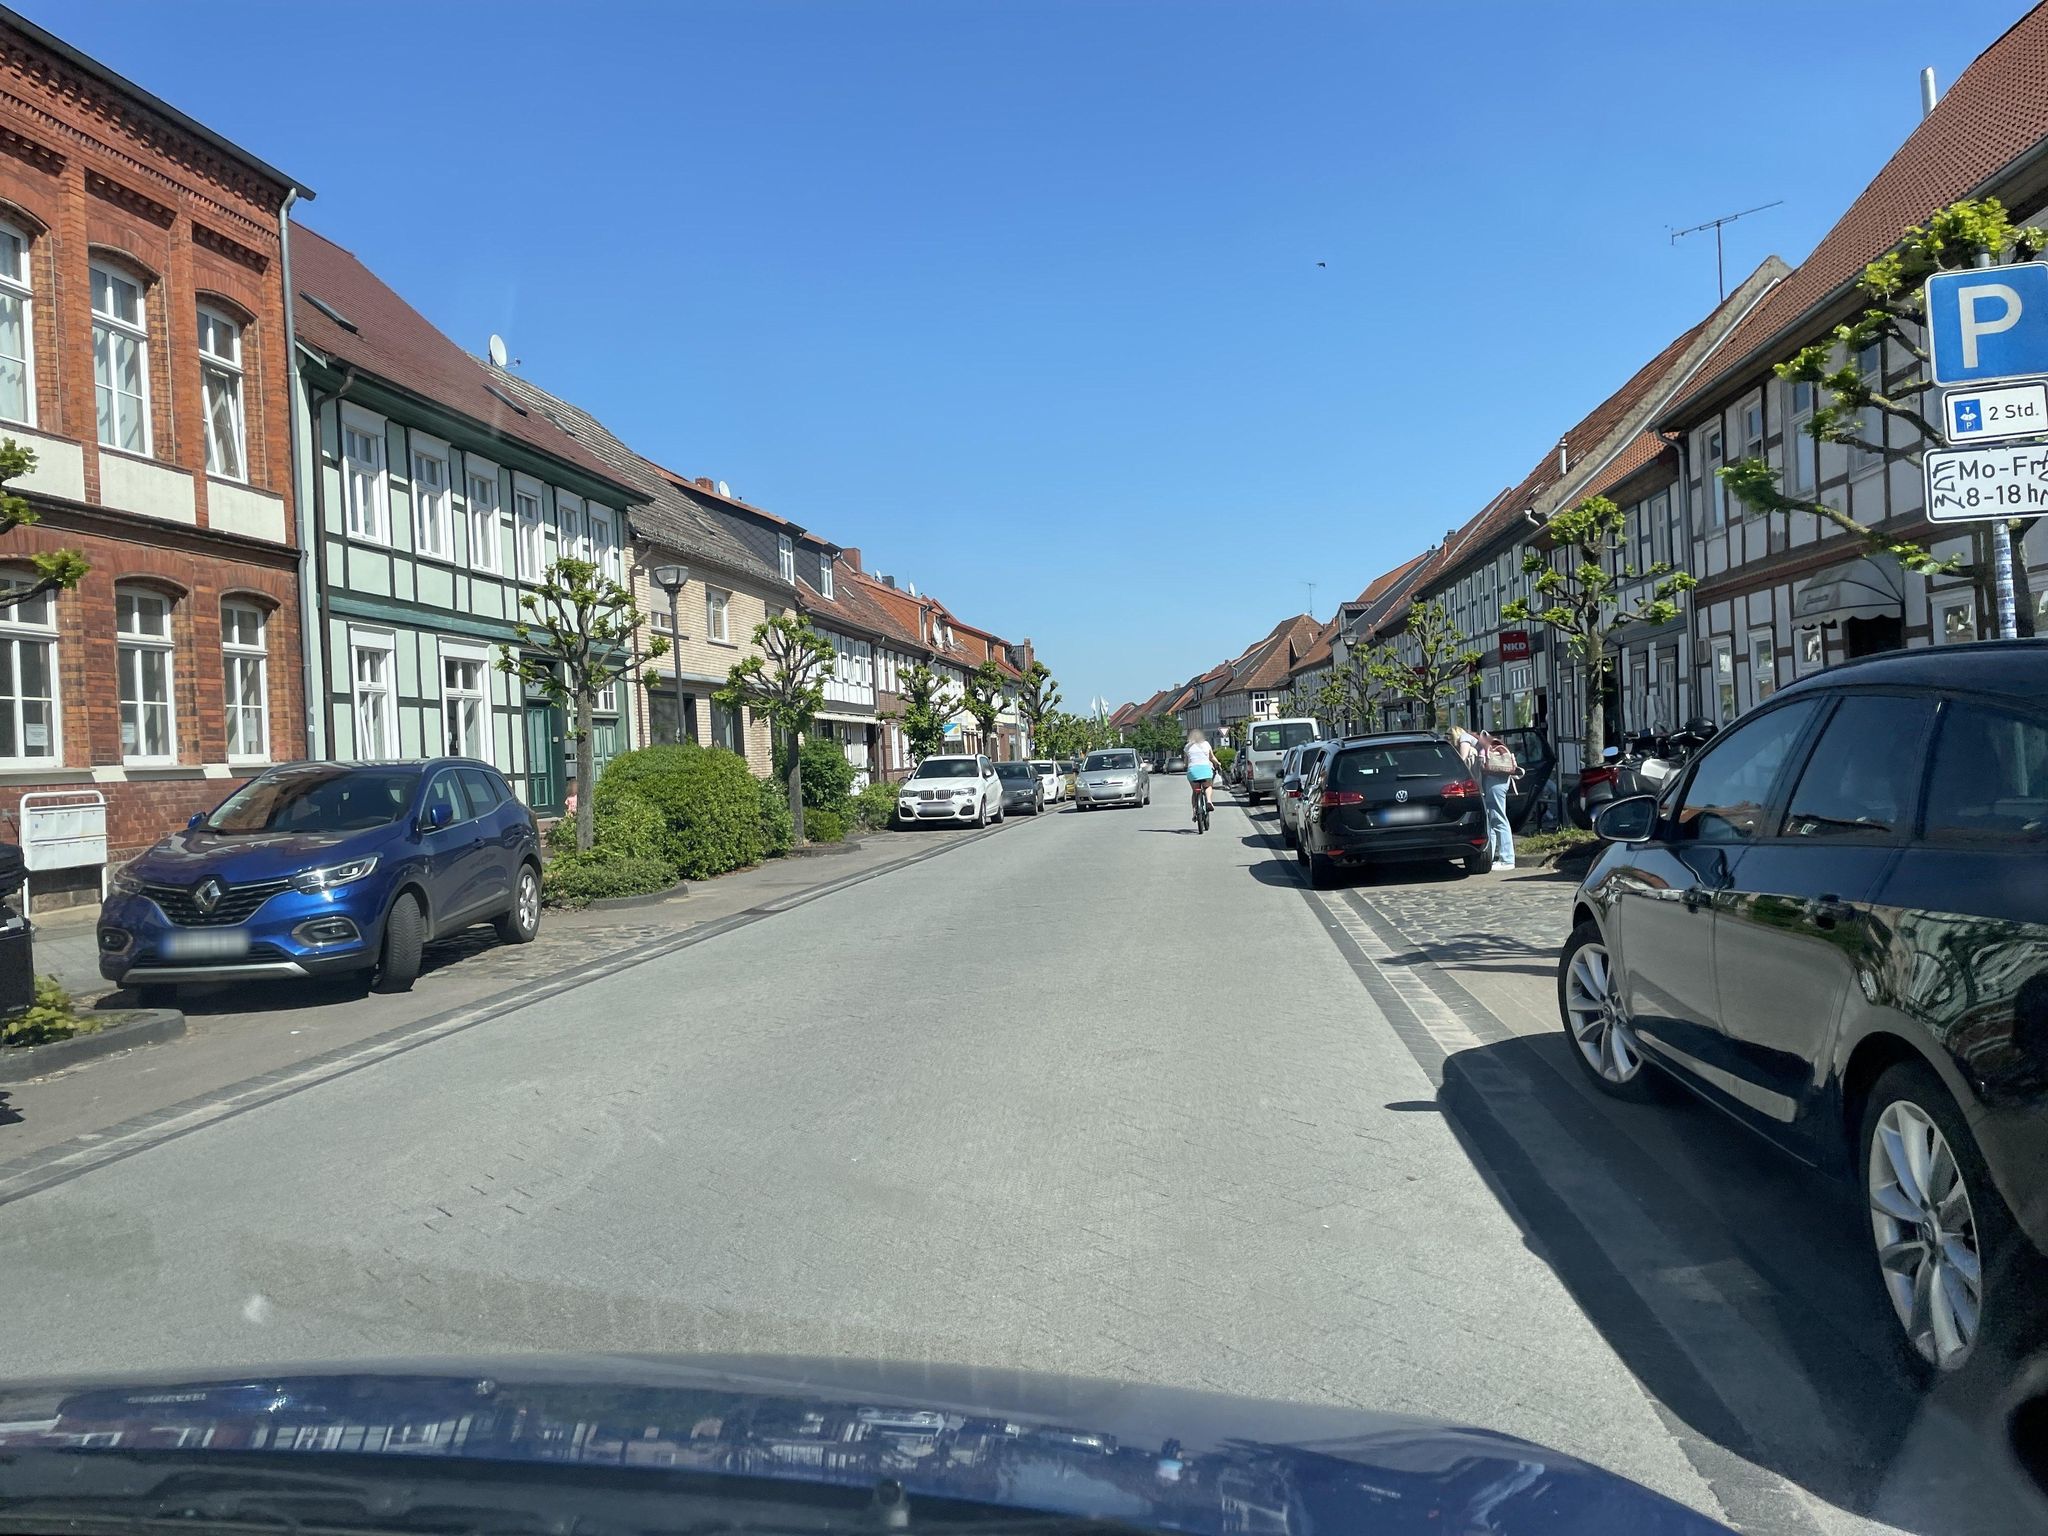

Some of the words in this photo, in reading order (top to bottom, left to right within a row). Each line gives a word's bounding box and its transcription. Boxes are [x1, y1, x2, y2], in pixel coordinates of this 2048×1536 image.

[1958, 283, 2023, 369] P
[1989, 406, 1999, 421] 2
[2004, 402, 2039, 419] Std.
[1966, 484, 2021, 507] 8-18
[1503, 642, 1527, 652] NKD
